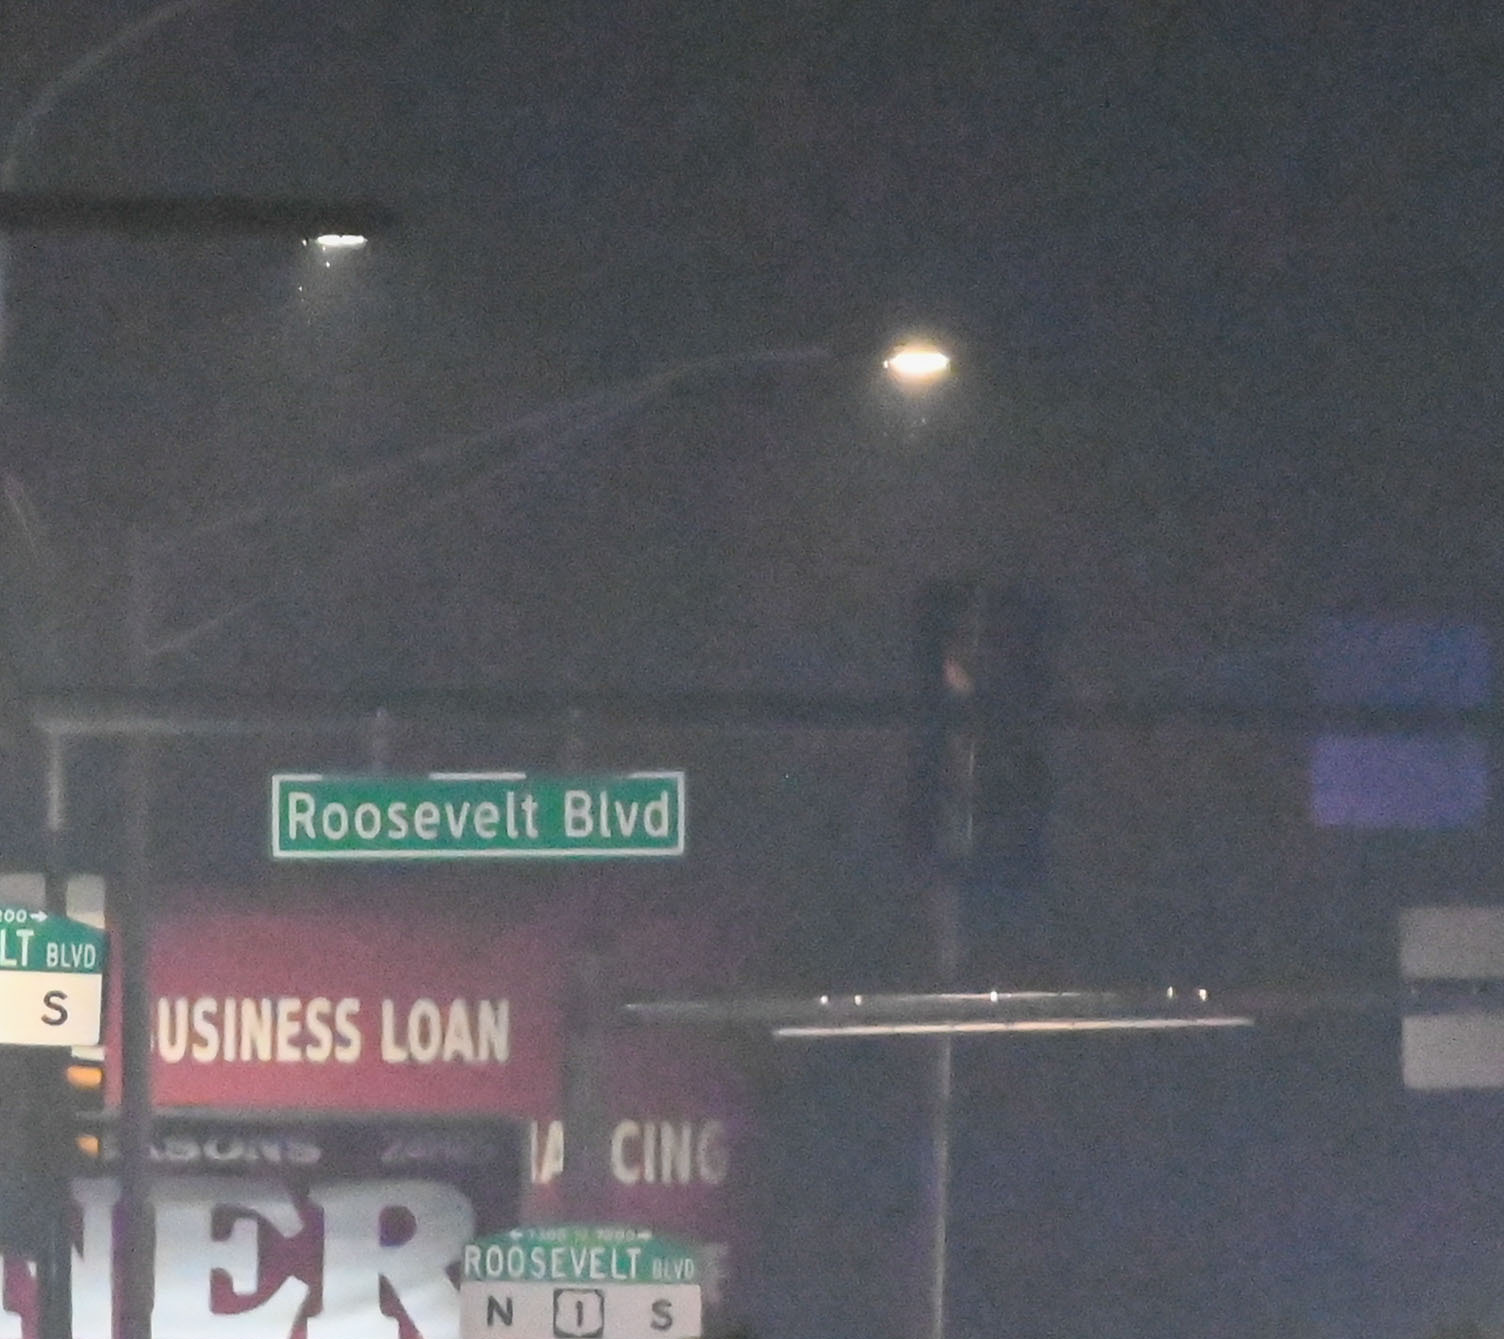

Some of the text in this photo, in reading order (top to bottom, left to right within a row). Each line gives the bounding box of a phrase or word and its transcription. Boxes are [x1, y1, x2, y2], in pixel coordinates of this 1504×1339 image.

[287, 789, 670, 840] Roosevelt Blvd
[46, 942, 96, 969] BLVD
[41, 990, 69, 1027] S
[150, 996, 510, 1064] USINESS LOAN
[463, 1244, 641, 1280] ROOSEVELT
[652, 1256, 696, 1281] BLVD
[486, 1295, 674, 1332] N 1 S
